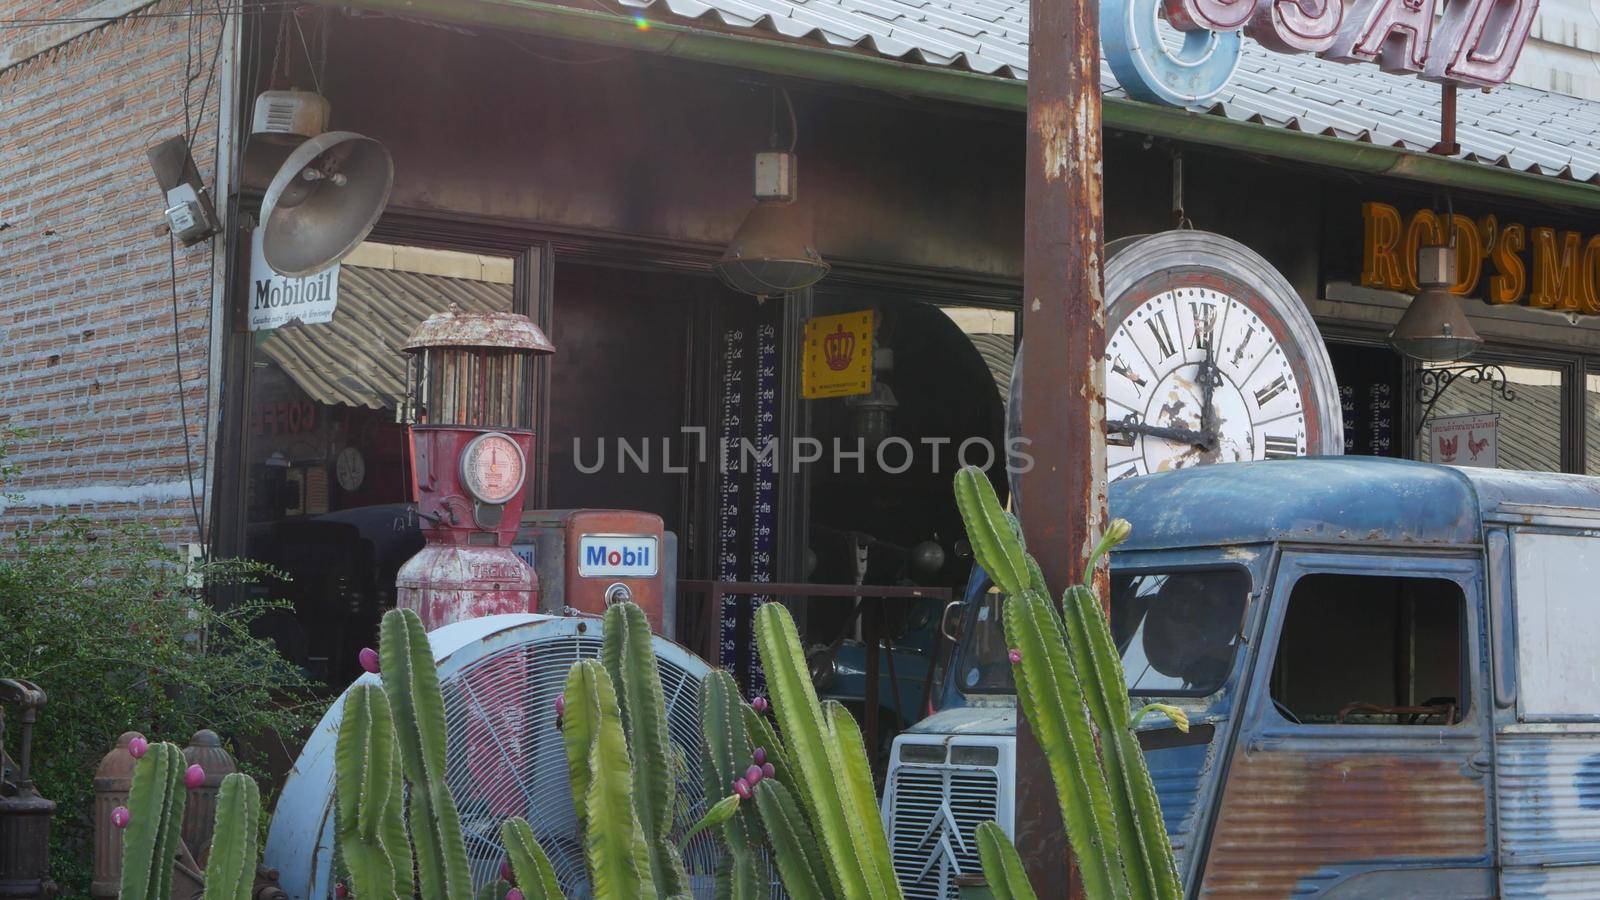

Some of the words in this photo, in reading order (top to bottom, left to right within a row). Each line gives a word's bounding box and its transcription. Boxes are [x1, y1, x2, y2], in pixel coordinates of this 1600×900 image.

[1361, 202, 1526, 304] ROD'S
[254, 271, 332, 310] Mobiloil
[586, 545, 649, 567] Mobil
